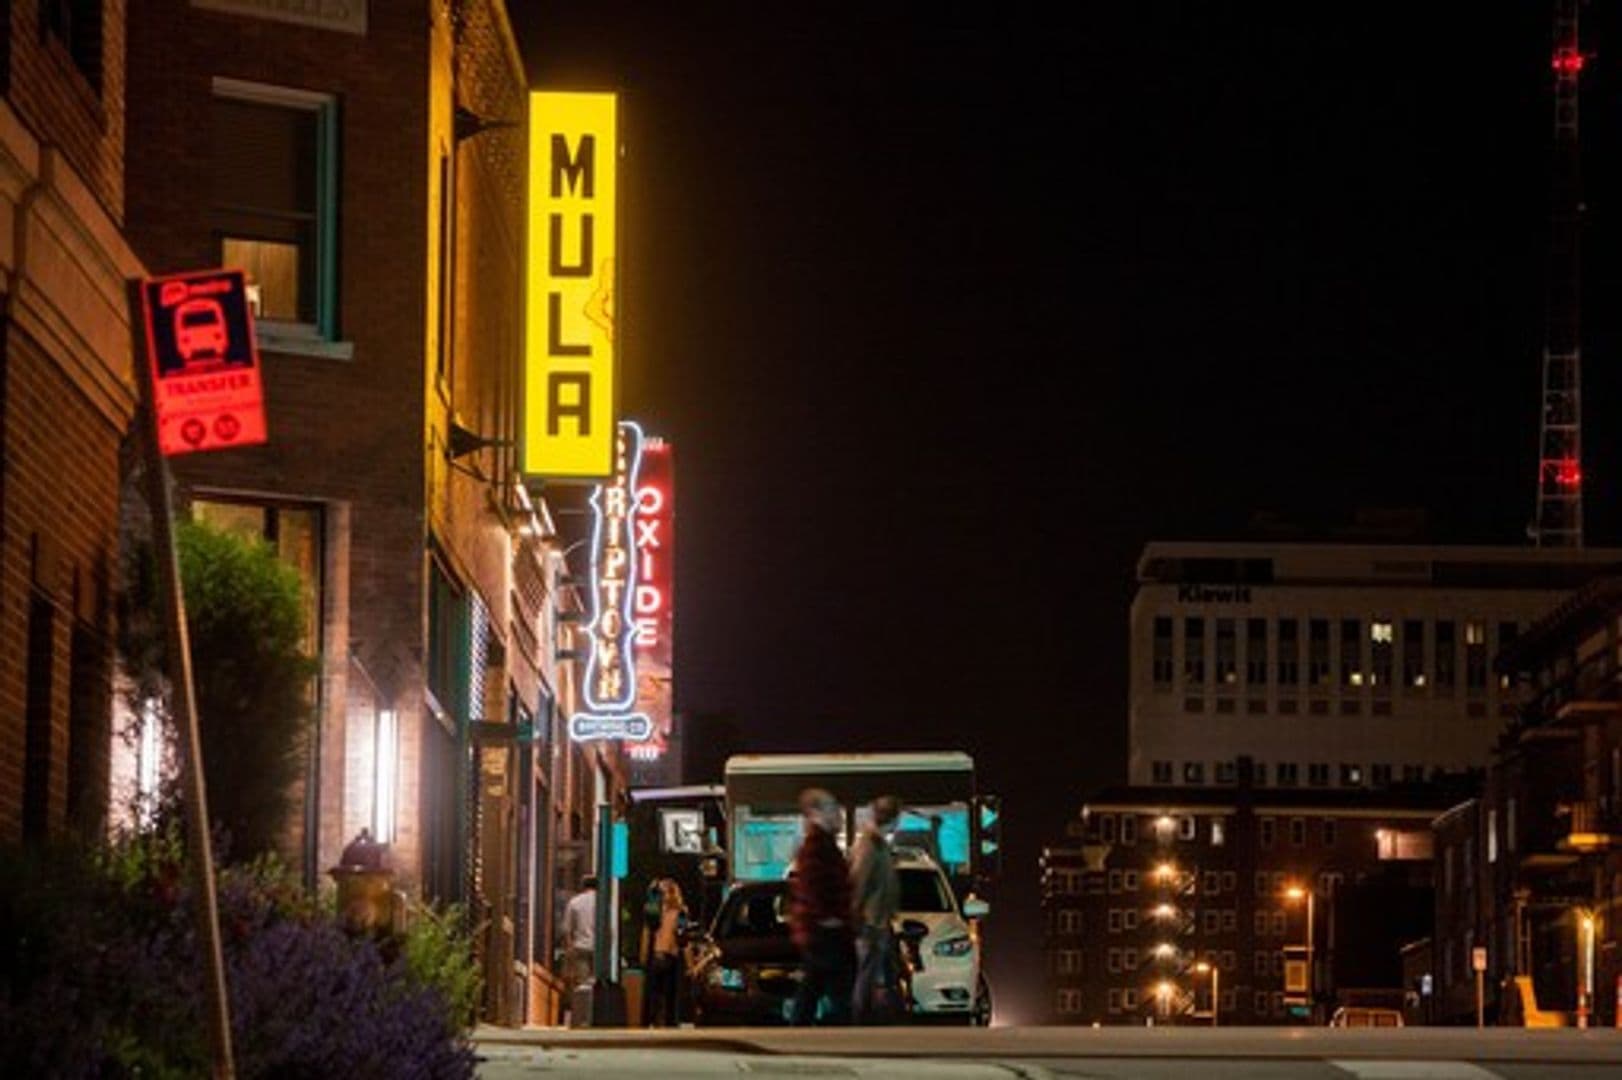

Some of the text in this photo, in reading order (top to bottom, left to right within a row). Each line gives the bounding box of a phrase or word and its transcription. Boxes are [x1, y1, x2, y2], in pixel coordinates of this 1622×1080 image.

[547, 134, 596, 436] MULA
[166, 374, 250, 397] TRANSFER
[635, 486, 663, 645] OXIDE
[1178, 583, 1252, 603] Kiewit
